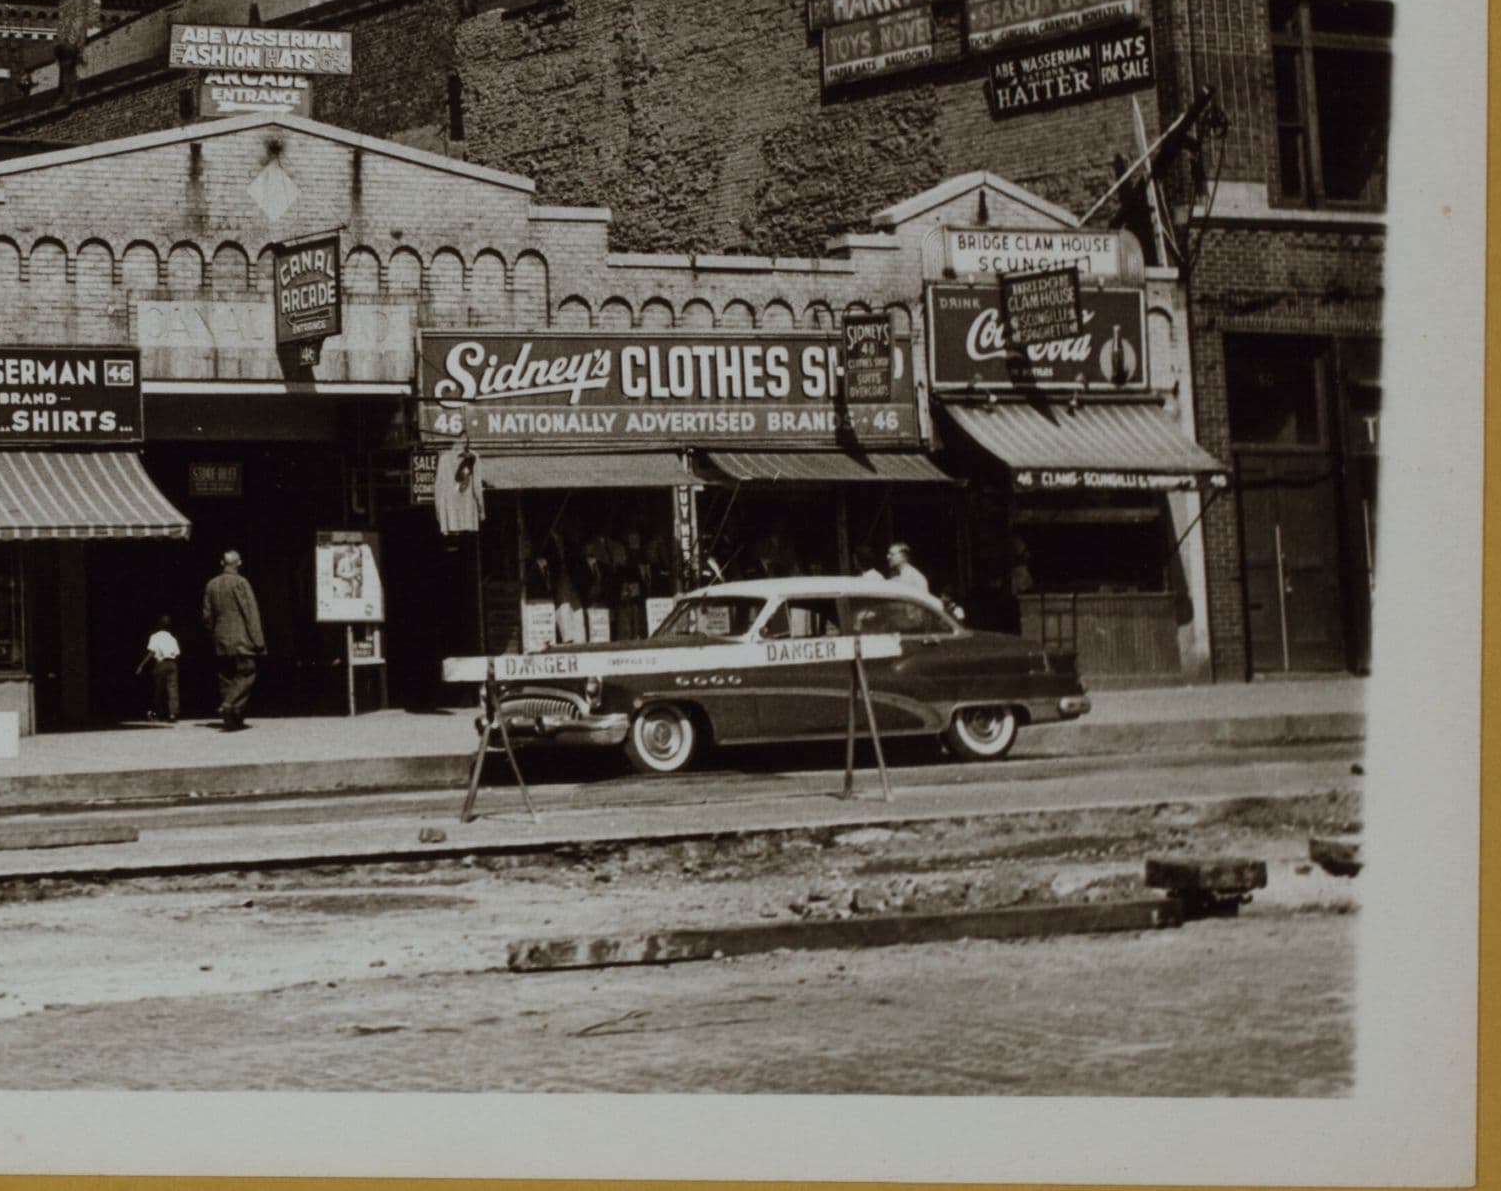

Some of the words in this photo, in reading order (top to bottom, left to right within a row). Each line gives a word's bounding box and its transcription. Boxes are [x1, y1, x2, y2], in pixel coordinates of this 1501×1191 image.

[181, 26, 222, 44] ABE
[224, 29, 343, 49] WASSERMAN
[830, 30, 871, 59] TOYS
[1101, 35, 1146, 62] HATS
[170, 43, 261, 68] FASHION
[264, 49, 315, 70] HATS
[995, 60, 1015, 79] ABE
[1020, 45, 1092, 73] WASSERMAN
[1100, 64, 1120, 86] FOR
[1122, 58, 1150, 81] SALE
[210, 88, 301, 105] ENTRANCE
[996, 71, 1093, 109] HATTER
[957, 234, 1009, 250] BRIDGE
[1015, 236, 1054, 250] CLAM
[1061, 237, 1112, 252] HOUSE
[279, 249, 336, 287] CANAL
[281, 281, 337, 314] ARCADE
[939, 297, 981, 309] DRINK
[107, 365, 132, 383] 46
[434, 342, 613, 408] Sidney's
[621, 345, 790, 398] CLOTHES
[434, 414, 463, 433] 46
[487, 412, 617, 433] NATIONALLY
[625, 410, 756, 433] ADVERTISED
[873, 409, 899, 431] 46
[765, 640, 837, 662] DANGER
[504, 655, 579, 677] DANGER
